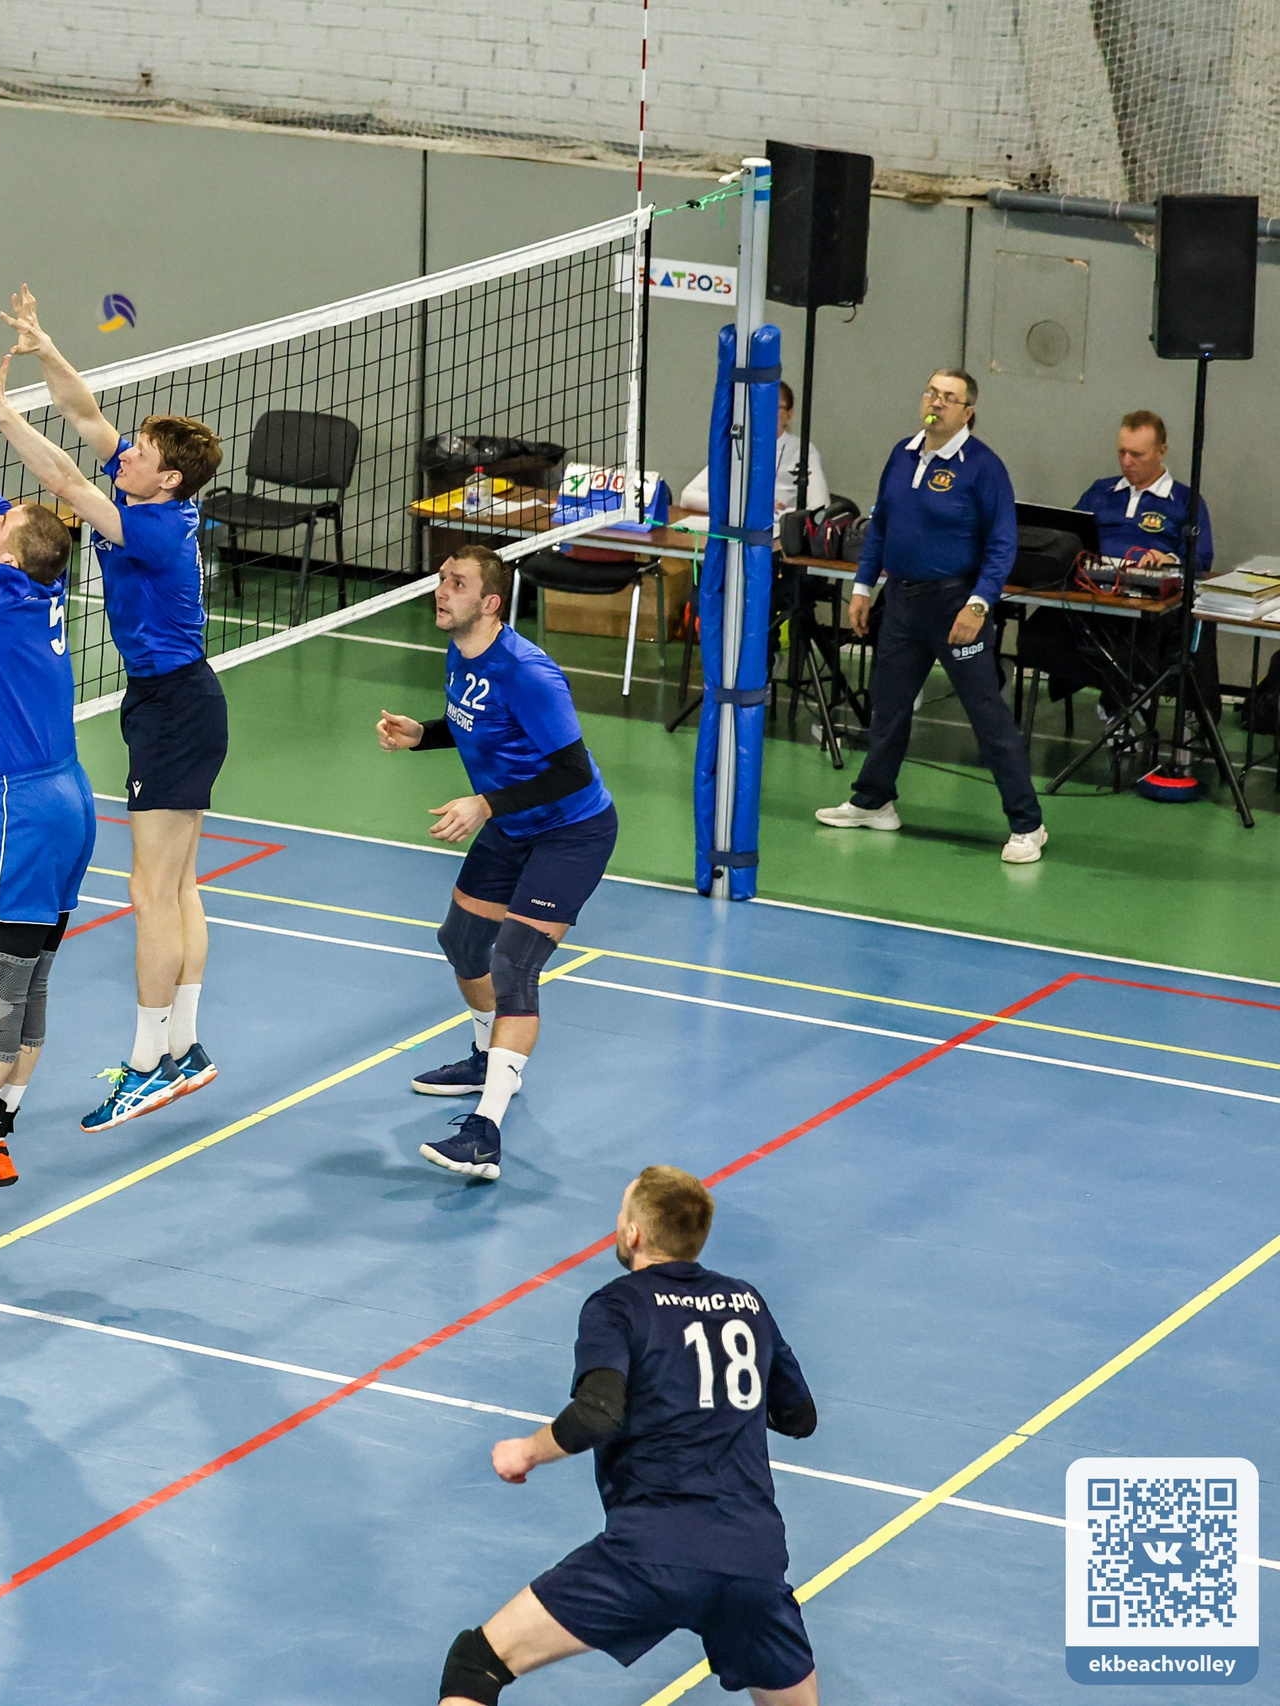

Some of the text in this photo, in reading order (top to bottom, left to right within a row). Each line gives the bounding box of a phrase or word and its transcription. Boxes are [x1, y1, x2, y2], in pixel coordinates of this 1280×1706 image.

[49, 597, 66, 655] 5
[460, 672, 490, 711] 22
[683, 1319, 762, 1411] 18
